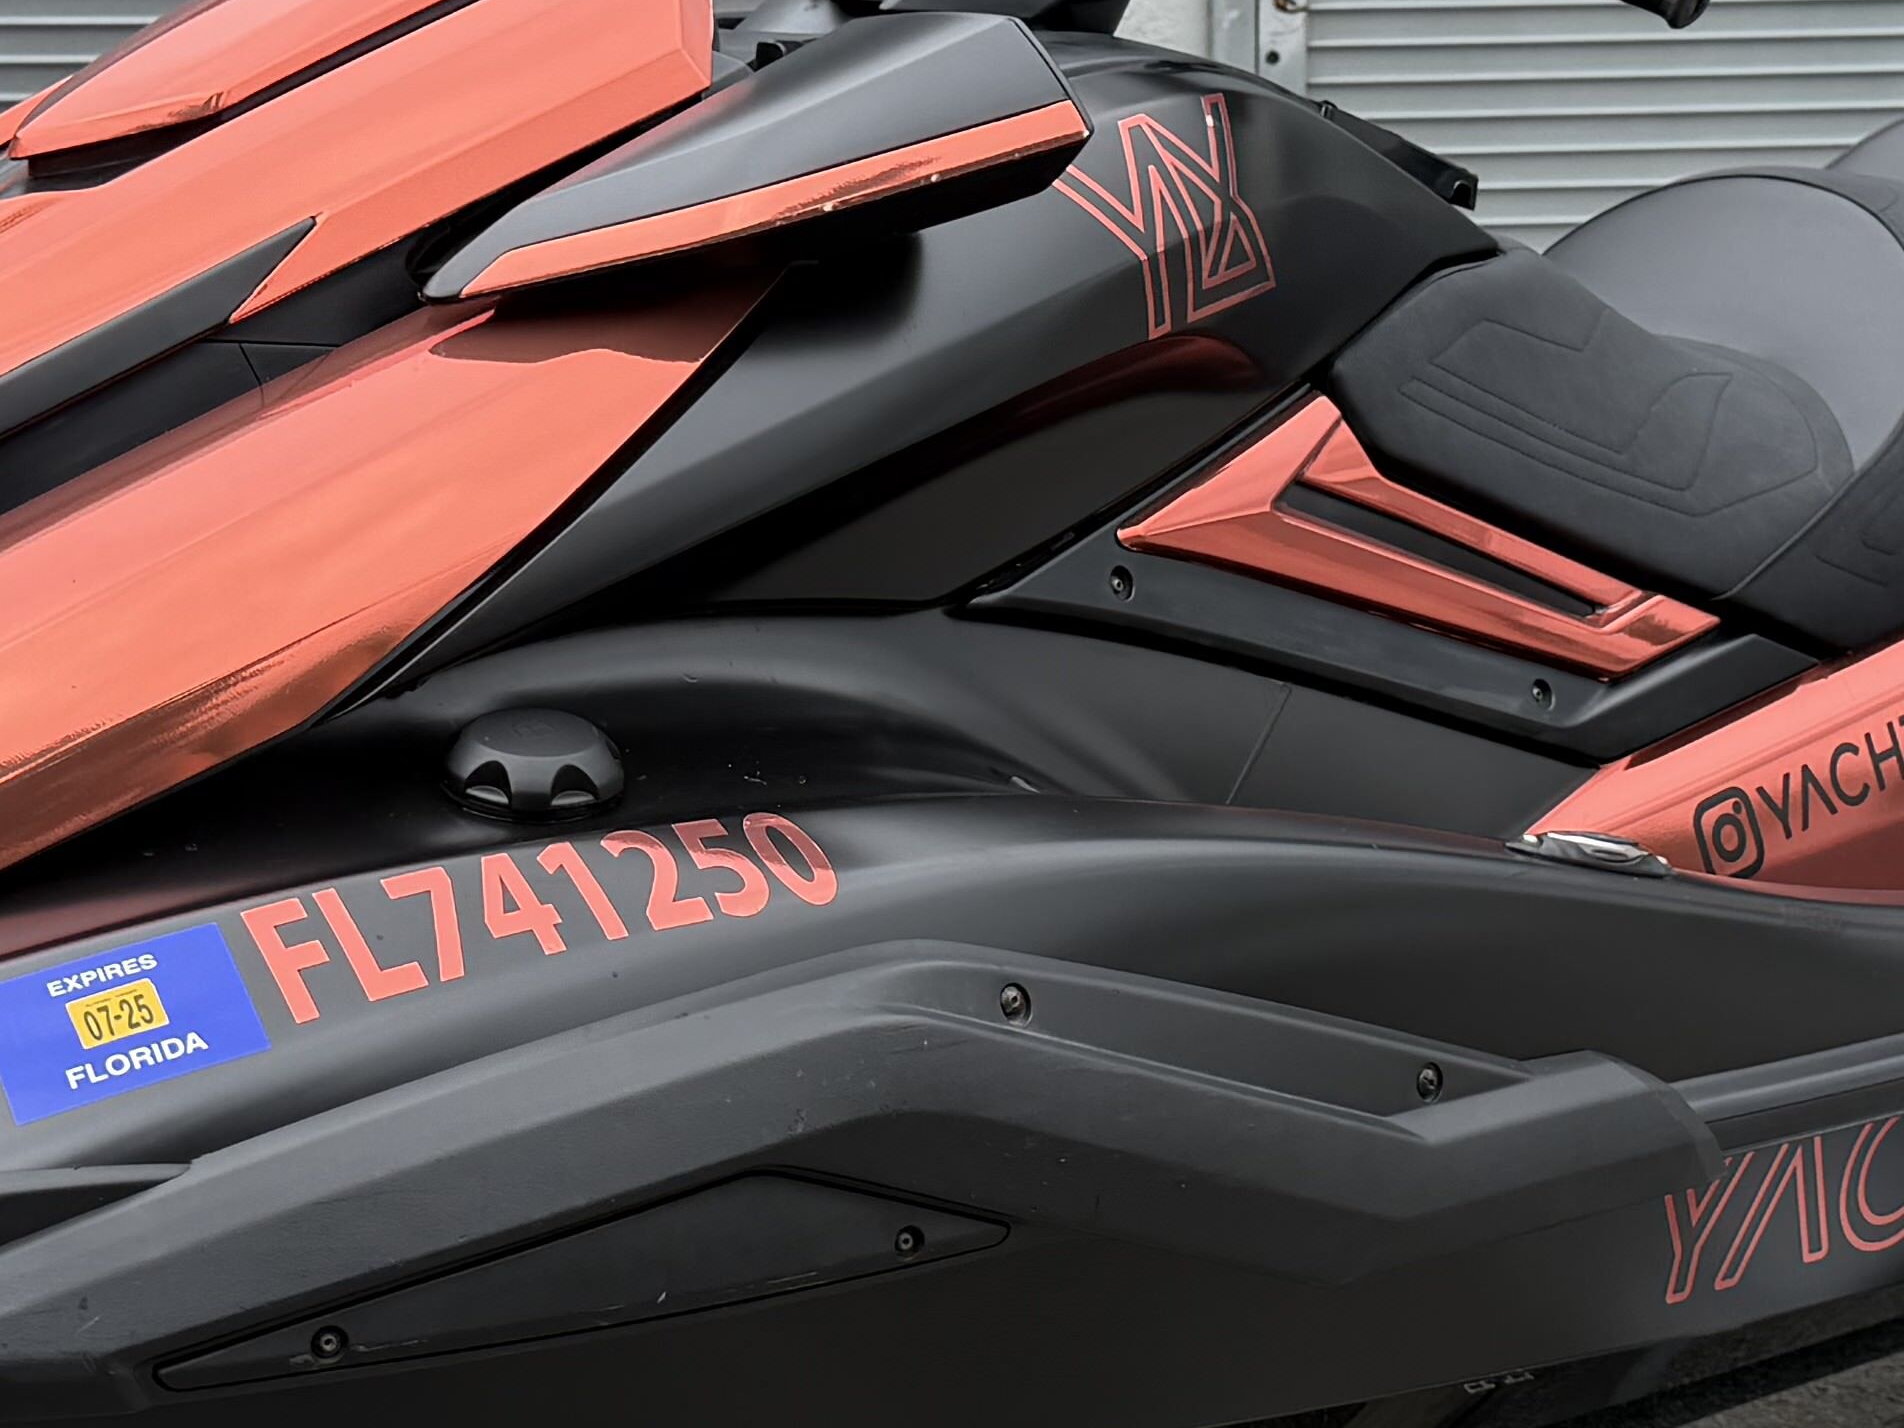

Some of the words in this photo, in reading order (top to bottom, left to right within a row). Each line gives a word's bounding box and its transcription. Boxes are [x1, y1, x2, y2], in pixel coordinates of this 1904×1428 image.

[46, 953, 159, 998] EXPIRES
[83, 993, 154, 1041] 07-25
[64, 1031, 209, 1090] FLORIDA
